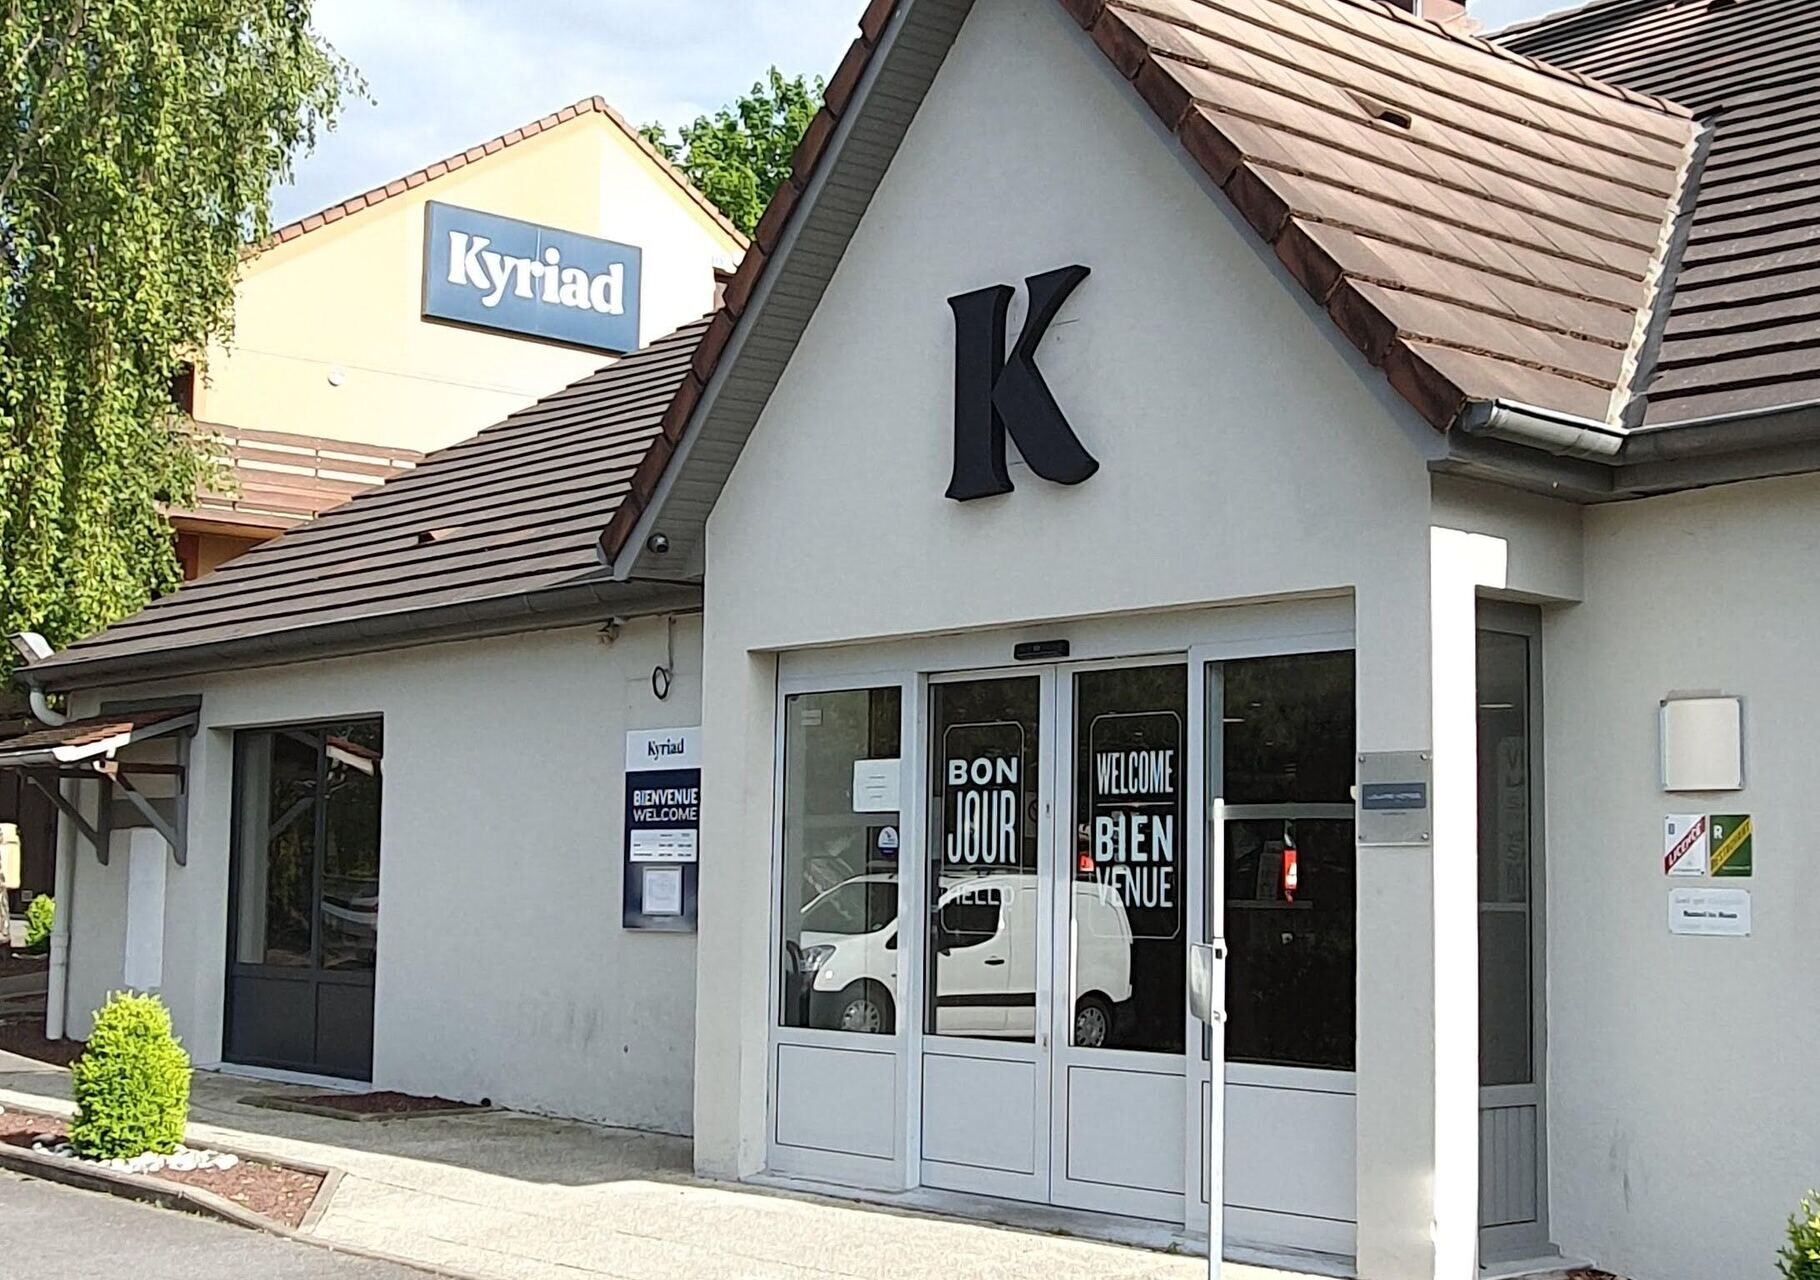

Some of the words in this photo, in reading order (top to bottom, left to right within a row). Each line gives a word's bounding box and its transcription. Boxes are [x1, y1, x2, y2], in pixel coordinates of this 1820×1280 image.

[448, 231, 625, 315] Kyriad
[945, 264, 1100, 503] K
[648, 738, 685, 761] Kyriad
[948, 757, 1018, 786] BON
[1096, 750, 1174, 795] WELCOME
[633, 788, 699, 807] BIENVENUE
[633, 807, 698, 822] WELCOME
[947, 789, 1016, 864] JOUR
[1095, 814, 1174, 862] BIEN
[1713, 824, 1723, 839] R
[1096, 865, 1174, 908] VENUE
